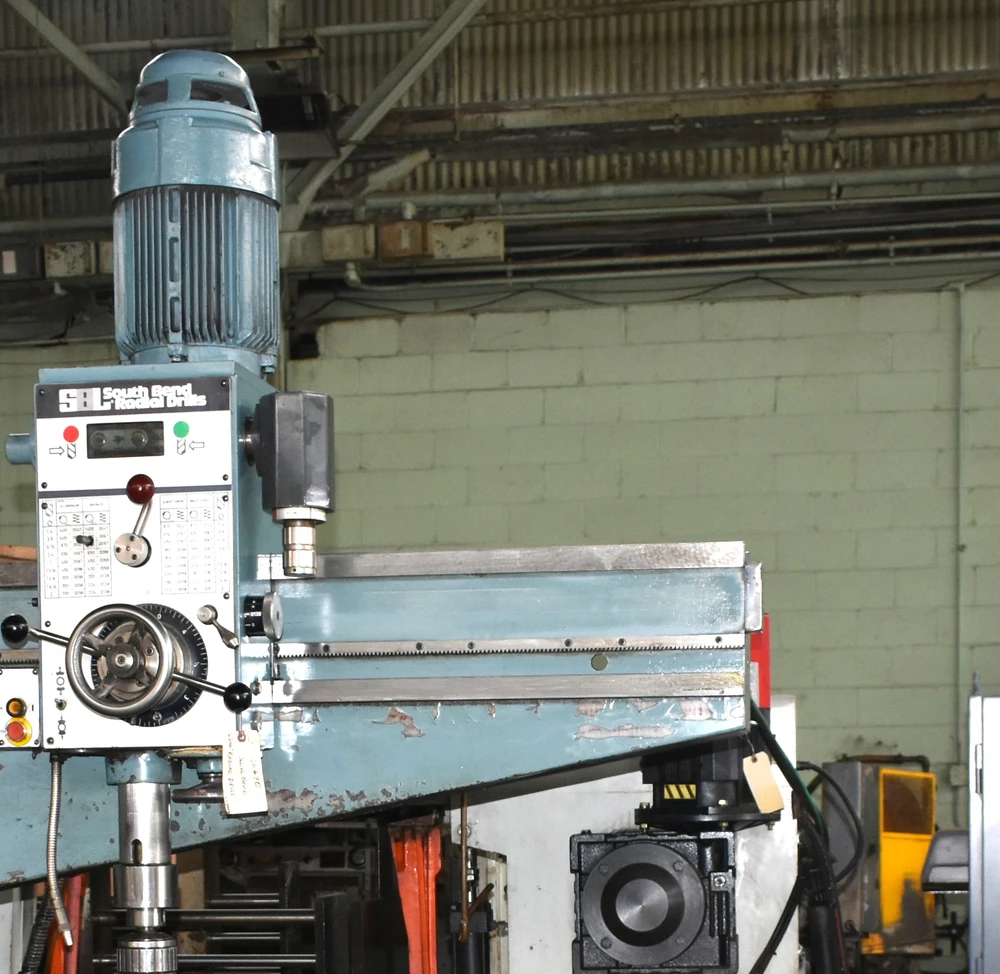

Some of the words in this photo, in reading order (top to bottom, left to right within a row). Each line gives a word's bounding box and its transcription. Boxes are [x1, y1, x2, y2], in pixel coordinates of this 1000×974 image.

[59, 387, 112, 413] SBL
[103, 385, 149, 400] South
[151, 383, 192, 398] Bend
[114, 396, 165, 410] Radial
[167, 394, 207, 408] Drills
